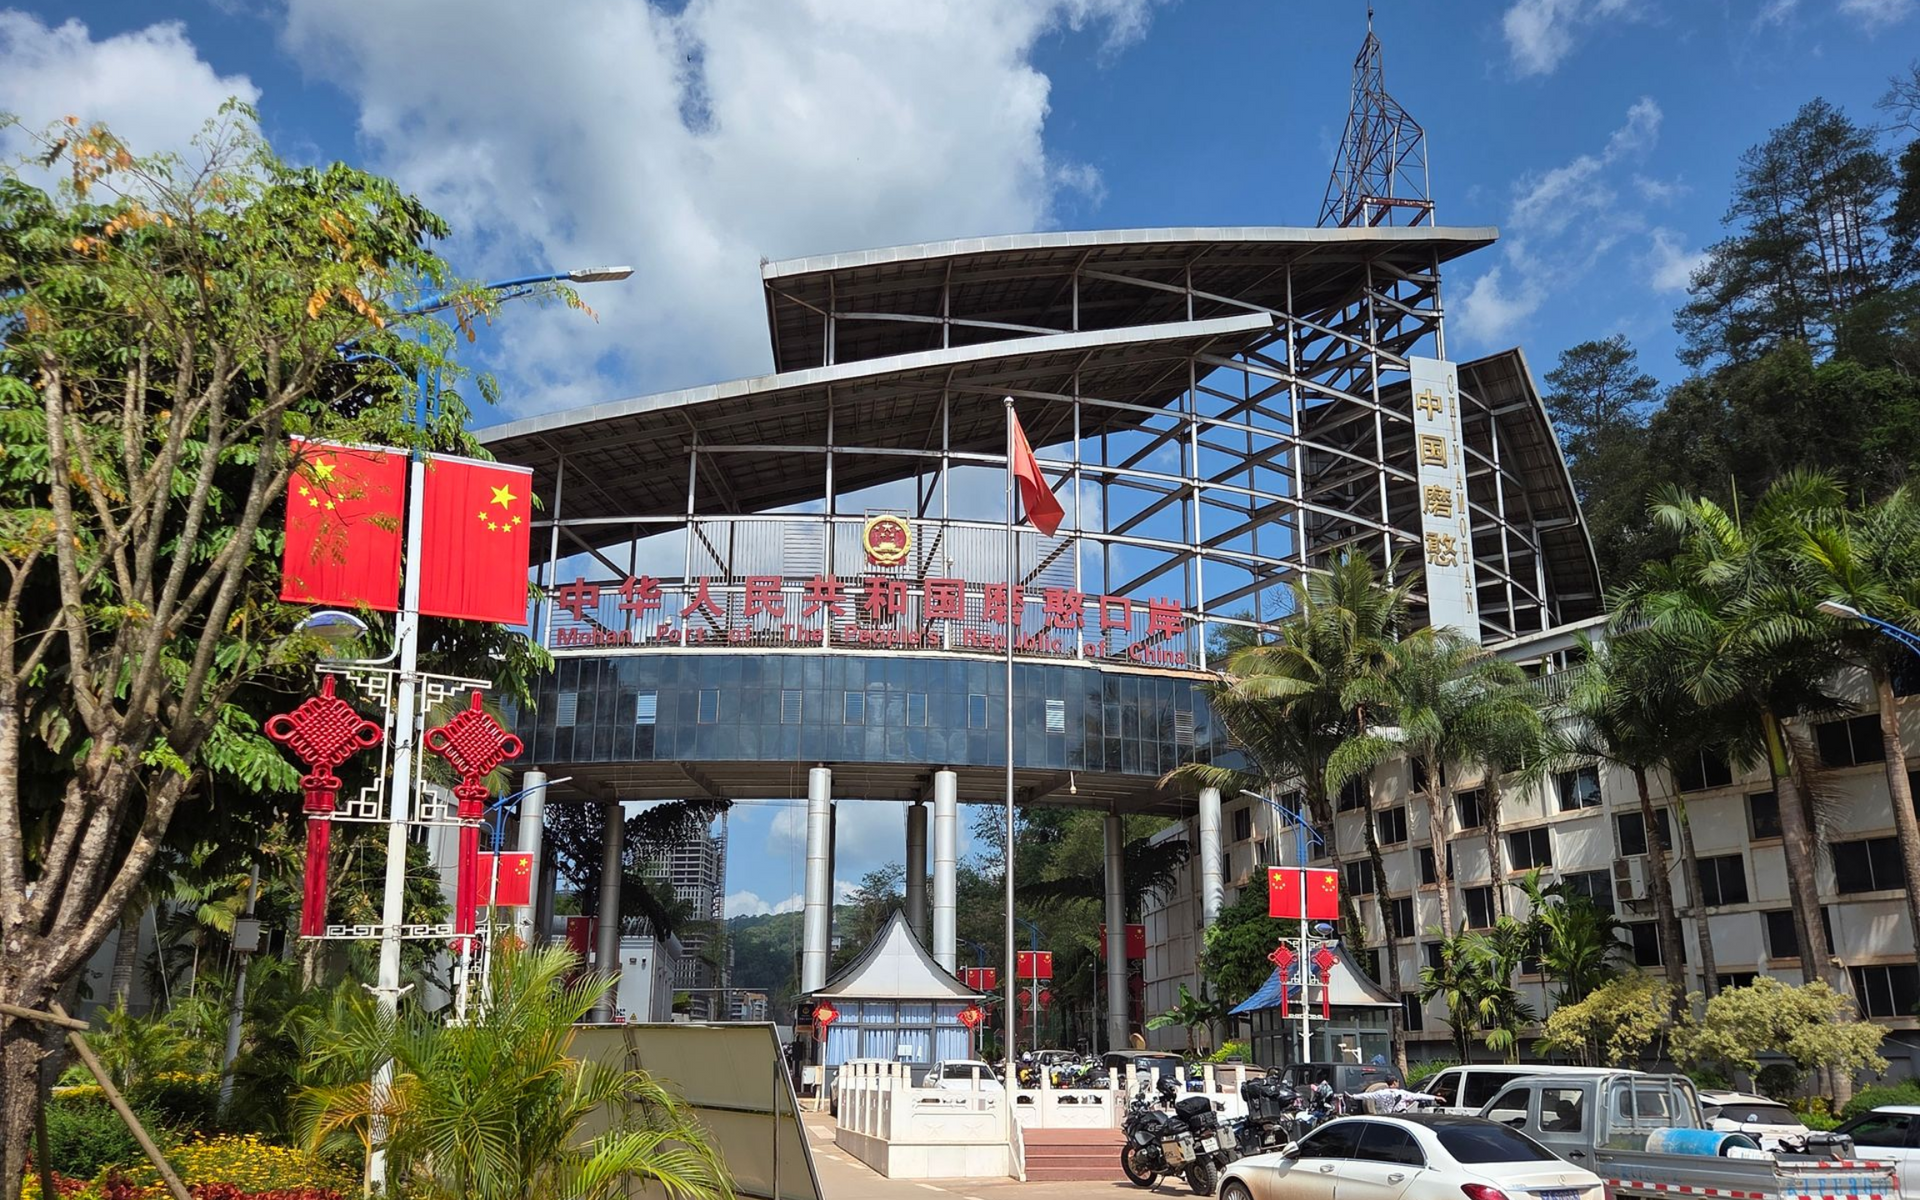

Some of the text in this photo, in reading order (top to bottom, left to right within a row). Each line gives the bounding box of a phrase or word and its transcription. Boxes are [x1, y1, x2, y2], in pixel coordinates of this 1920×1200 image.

[1415, 388, 1458, 568] 中国磨憨
[559, 574, 1185, 640] 中华人民共和国磨憨口岸
[556, 626, 632, 646] Mohan
[656, 624, 705, 643] Port
[728, 624, 752, 643] of
[782, 623, 824, 643] The
[845, 624, 940, 646] People's
[1083, 638, 1106, 657] of
[1129, 641, 1186, 665] China
